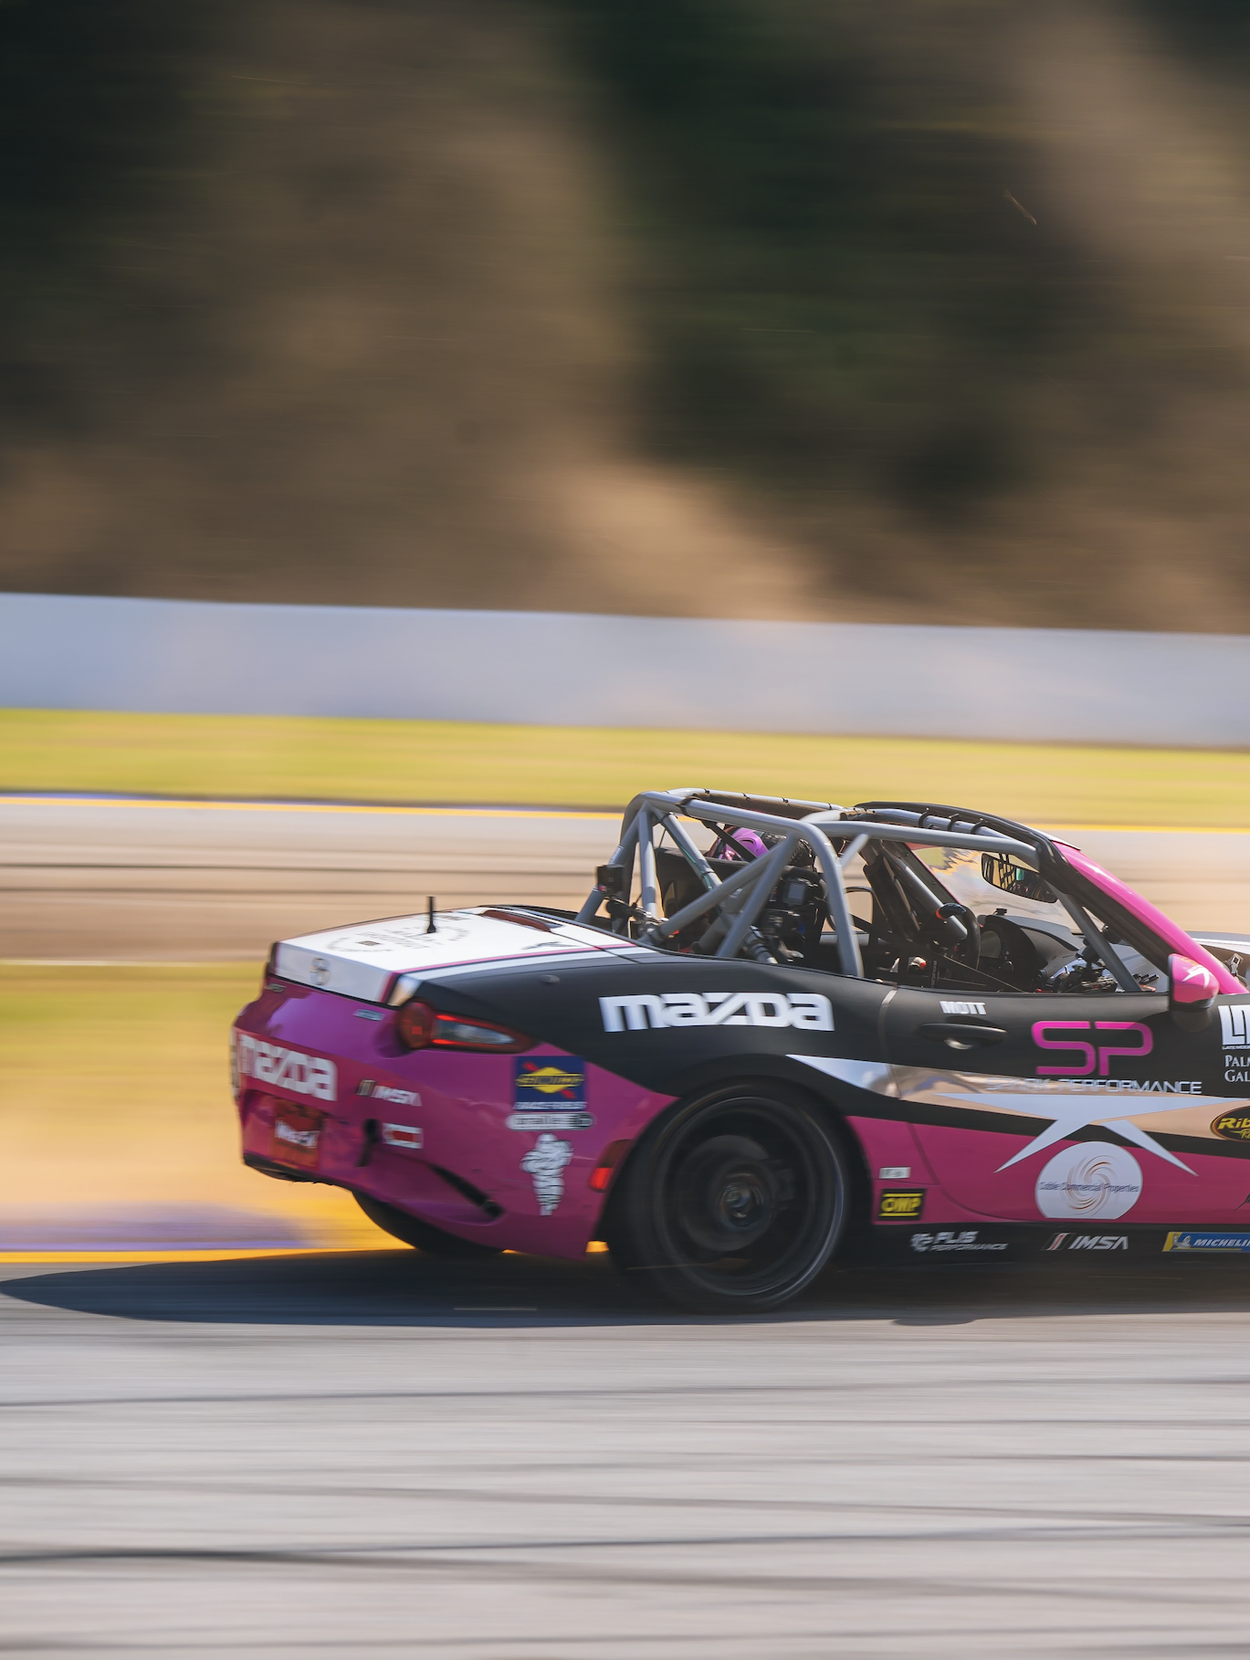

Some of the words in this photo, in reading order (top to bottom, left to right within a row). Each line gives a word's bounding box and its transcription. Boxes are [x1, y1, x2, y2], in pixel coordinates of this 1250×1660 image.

[1031, 1020, 1154, 1076] SP
[1058, 1078, 1202, 1094] PERFORMANCE
[881, 1198, 922, 1213] OMP
[1068, 1235, 1129, 1250] IMSA
